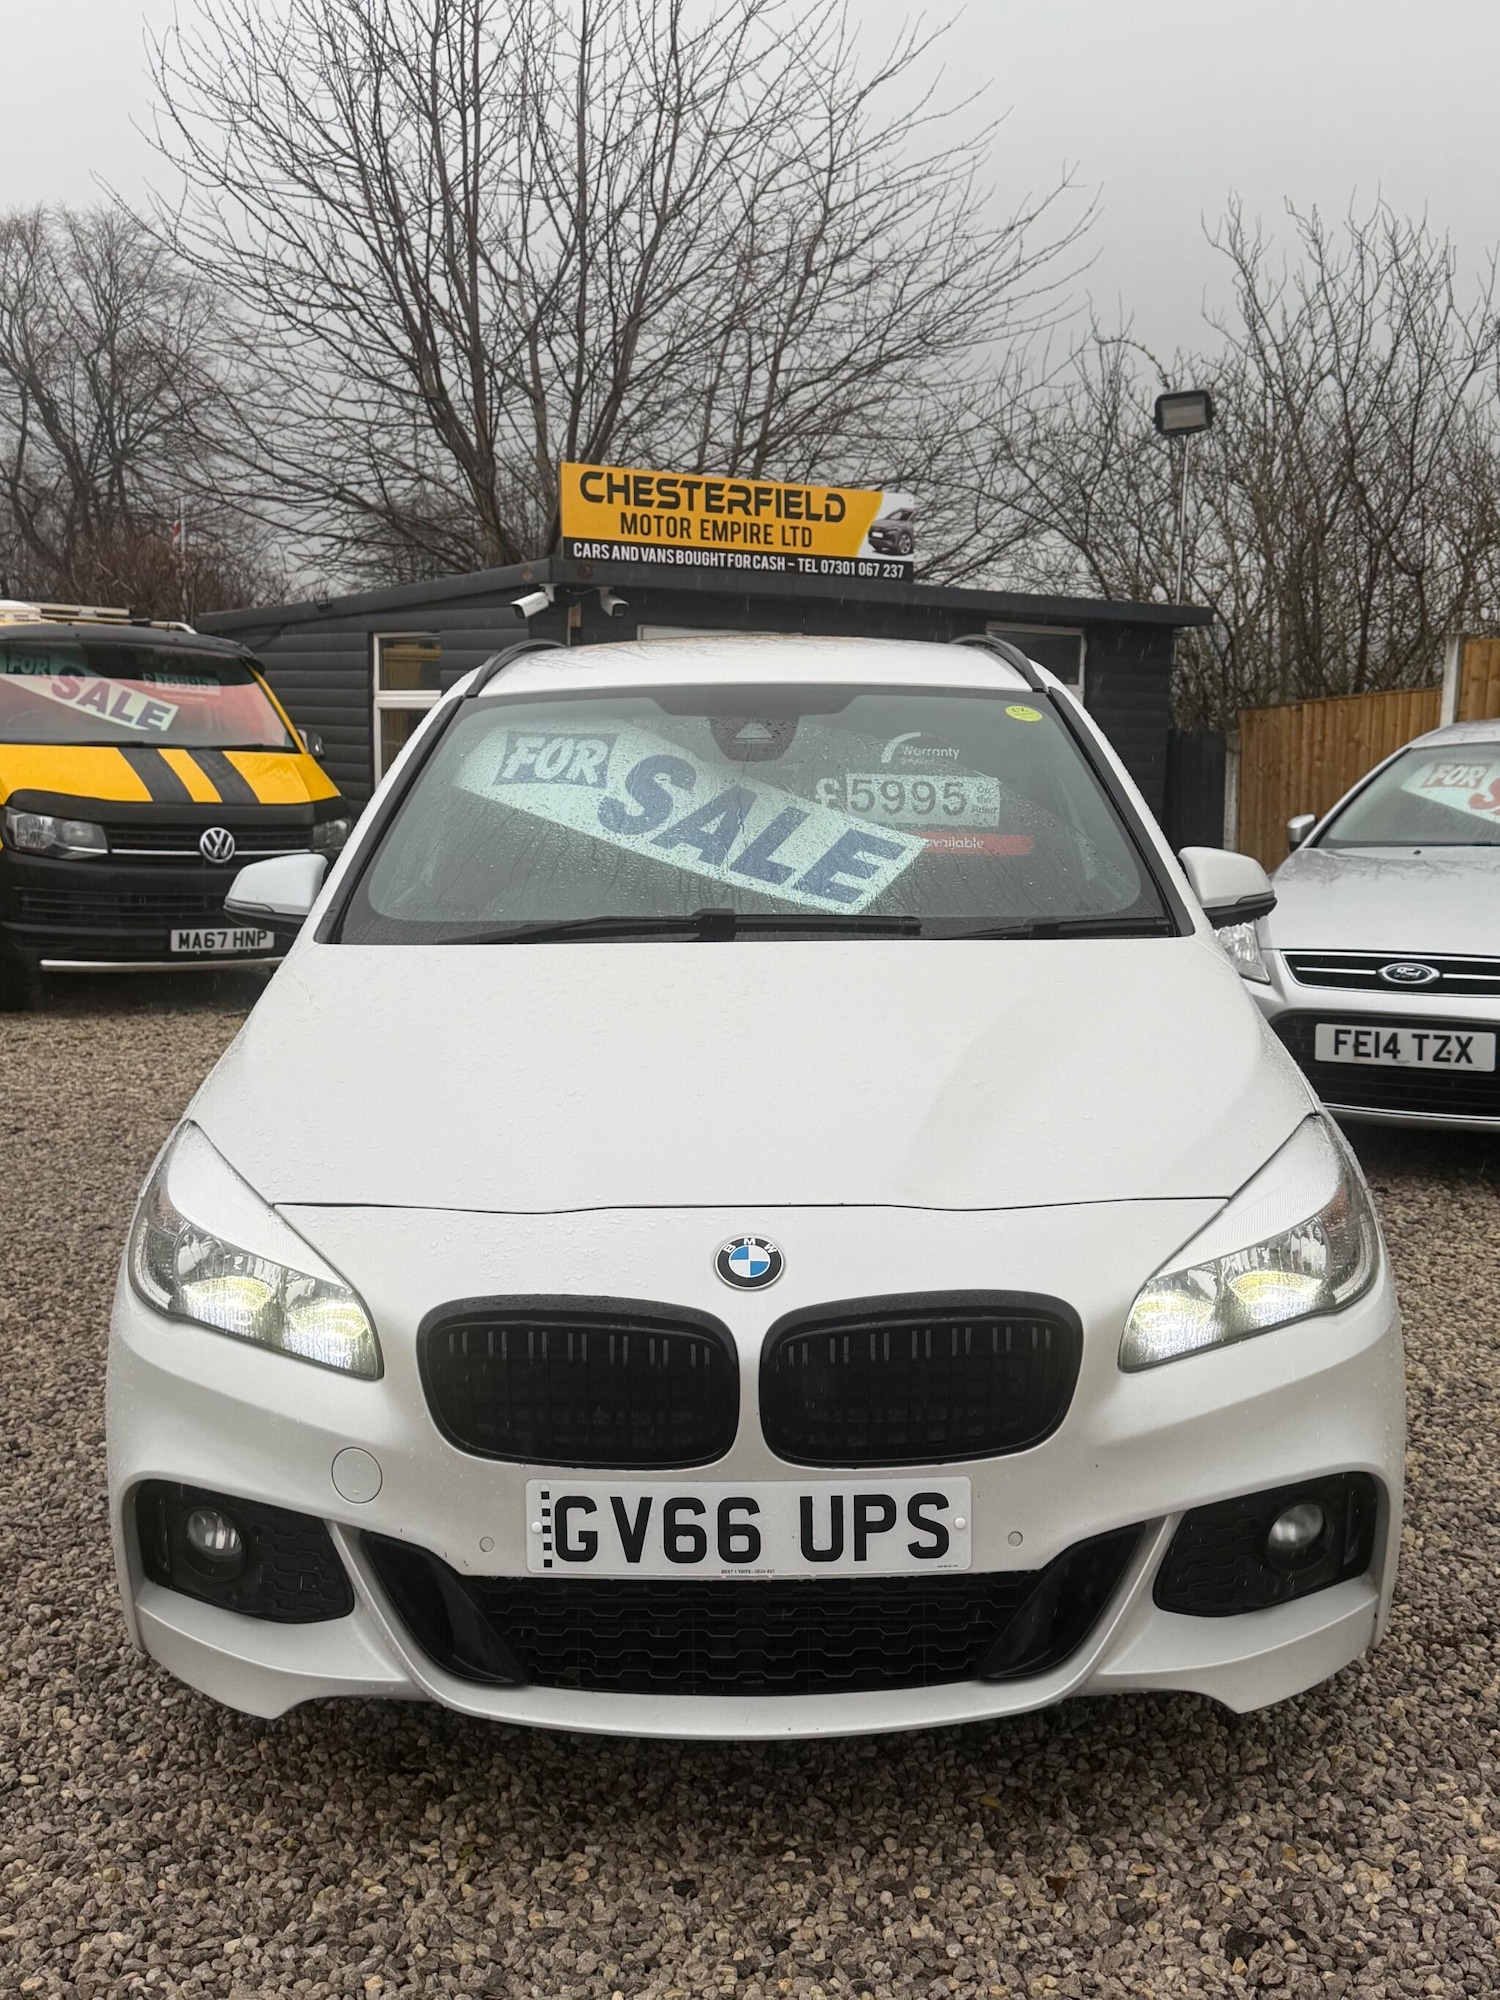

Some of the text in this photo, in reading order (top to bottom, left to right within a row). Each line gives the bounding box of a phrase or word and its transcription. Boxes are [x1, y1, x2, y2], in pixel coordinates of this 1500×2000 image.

[579, 471, 846, 523] CHESTERFIELD
[620, 512, 813, 548] MOTOR EMPIRE LTD
[573, 541, 610, 560] CARS
[611, 545, 639, 562] AND
[640, 547, 675, 565] VANS
[675, 549, 726, 568] BOUGHT
[726, 552, 750, 569] FOR
[752, 554, 786, 571] CASH
[797, 557, 819, 573] TEL
[820, 559, 856, 575] 07301
[858, 562, 880, 577] 067
[882, 564, 905, 579] 237
[7, 656, 50, 680] FOR
[51, 666, 172, 732] SALE
[502, 735, 606, 784] FOR
[1426, 764, 1488, 788] FOR
[814, 777, 968, 817] £5995
[597, 754, 910, 904] SALE
[178, 930, 267, 949] MA67 HNP
[1334, 1028, 1474, 1064] FE14 TZX
[722, 1238, 777, 1254] BMW
[554, 1492, 950, 1564] GV66 UPS
